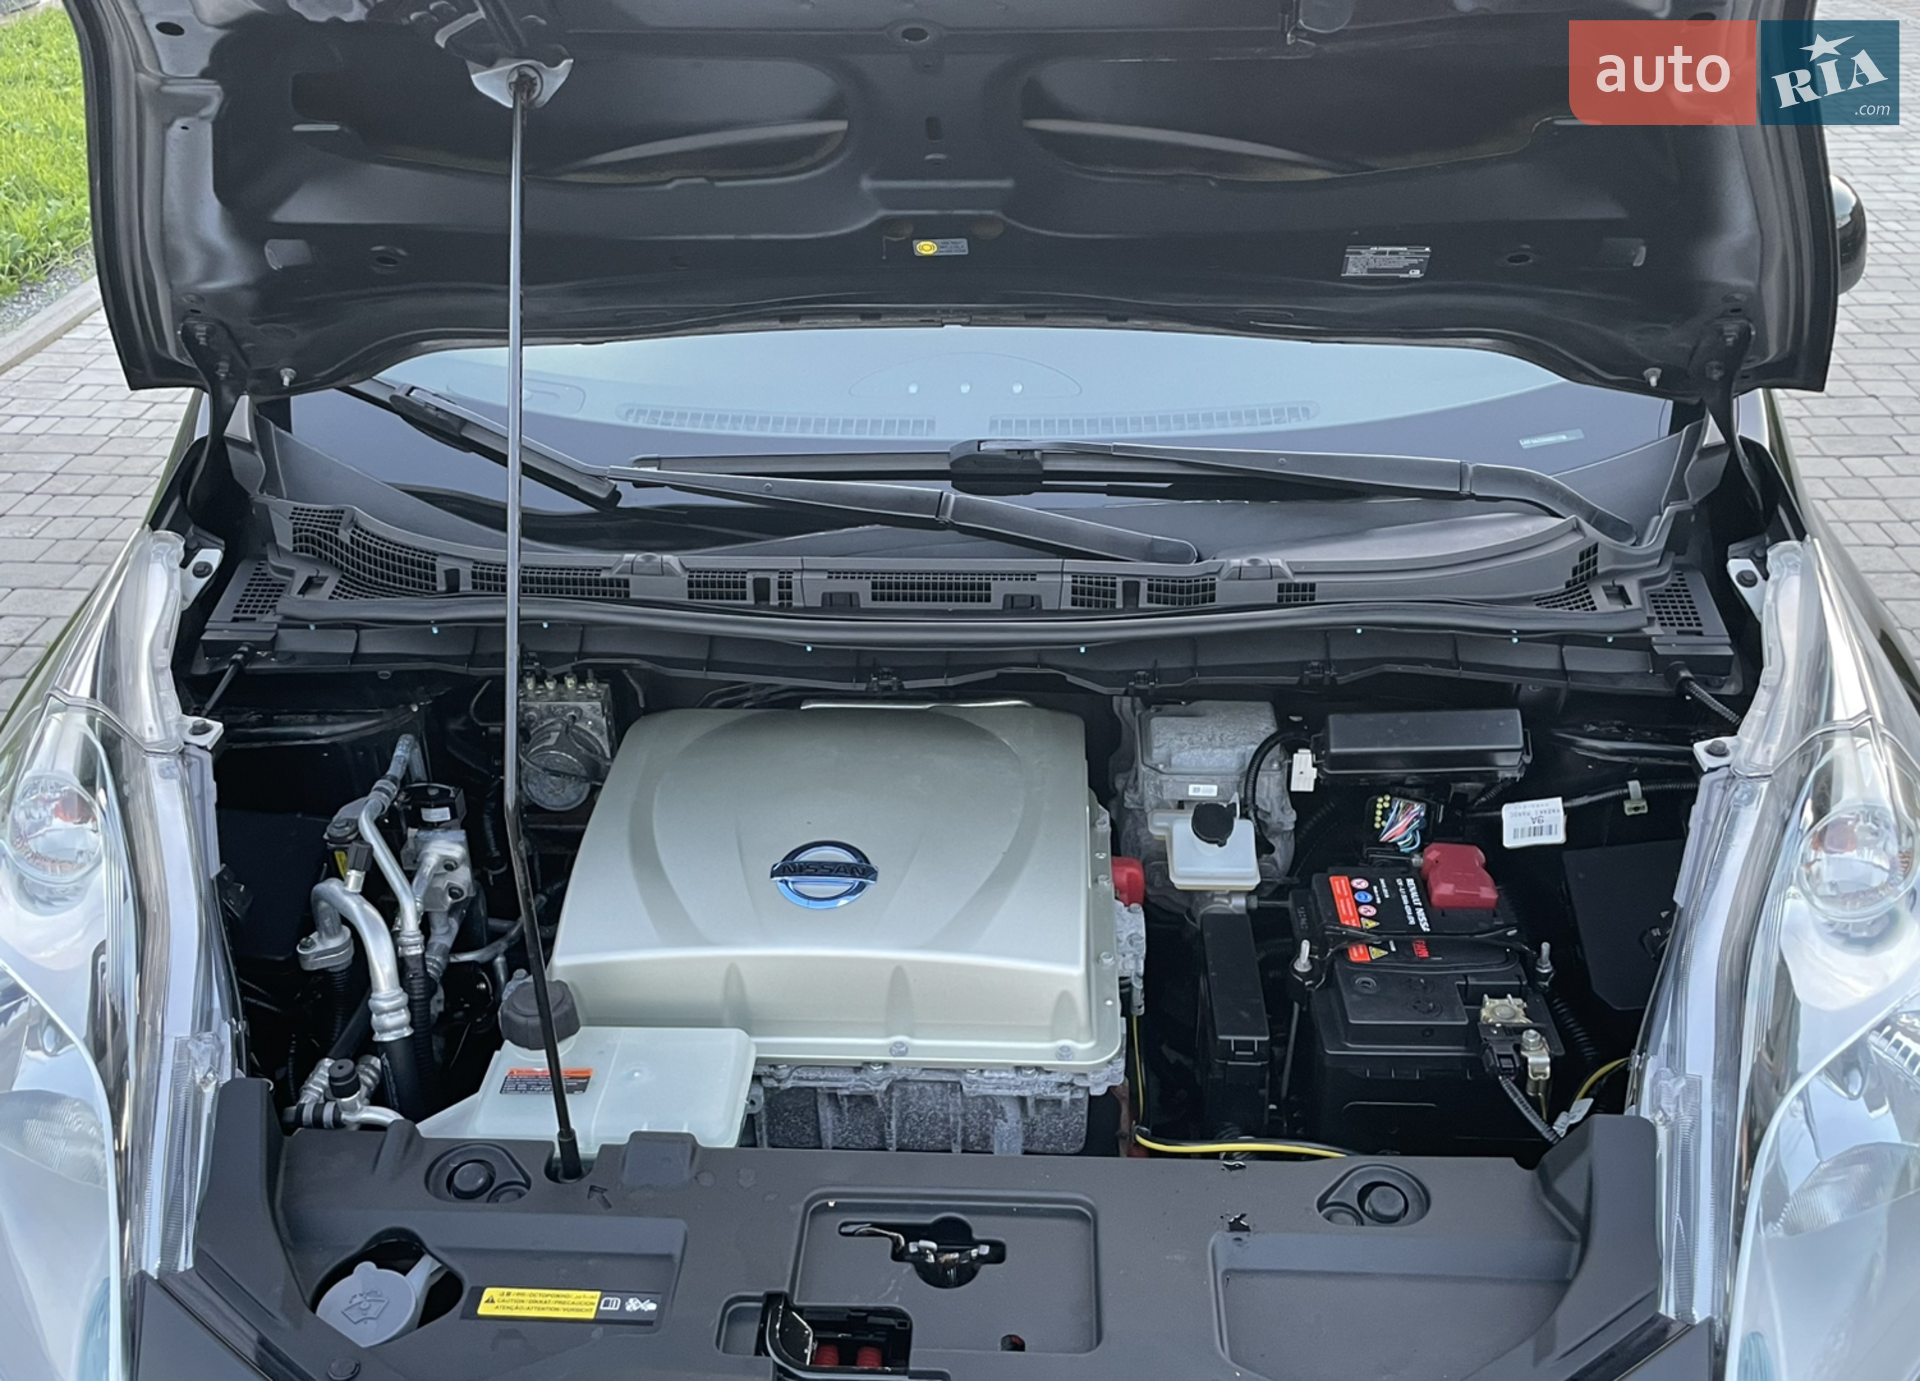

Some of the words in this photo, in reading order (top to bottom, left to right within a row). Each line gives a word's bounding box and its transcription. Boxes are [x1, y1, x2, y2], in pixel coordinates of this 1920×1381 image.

[1530, 815, 1545, 825] 9A
[781, 862, 867, 877] NISSAN
[1406, 878, 1422, 906] RENAULT
